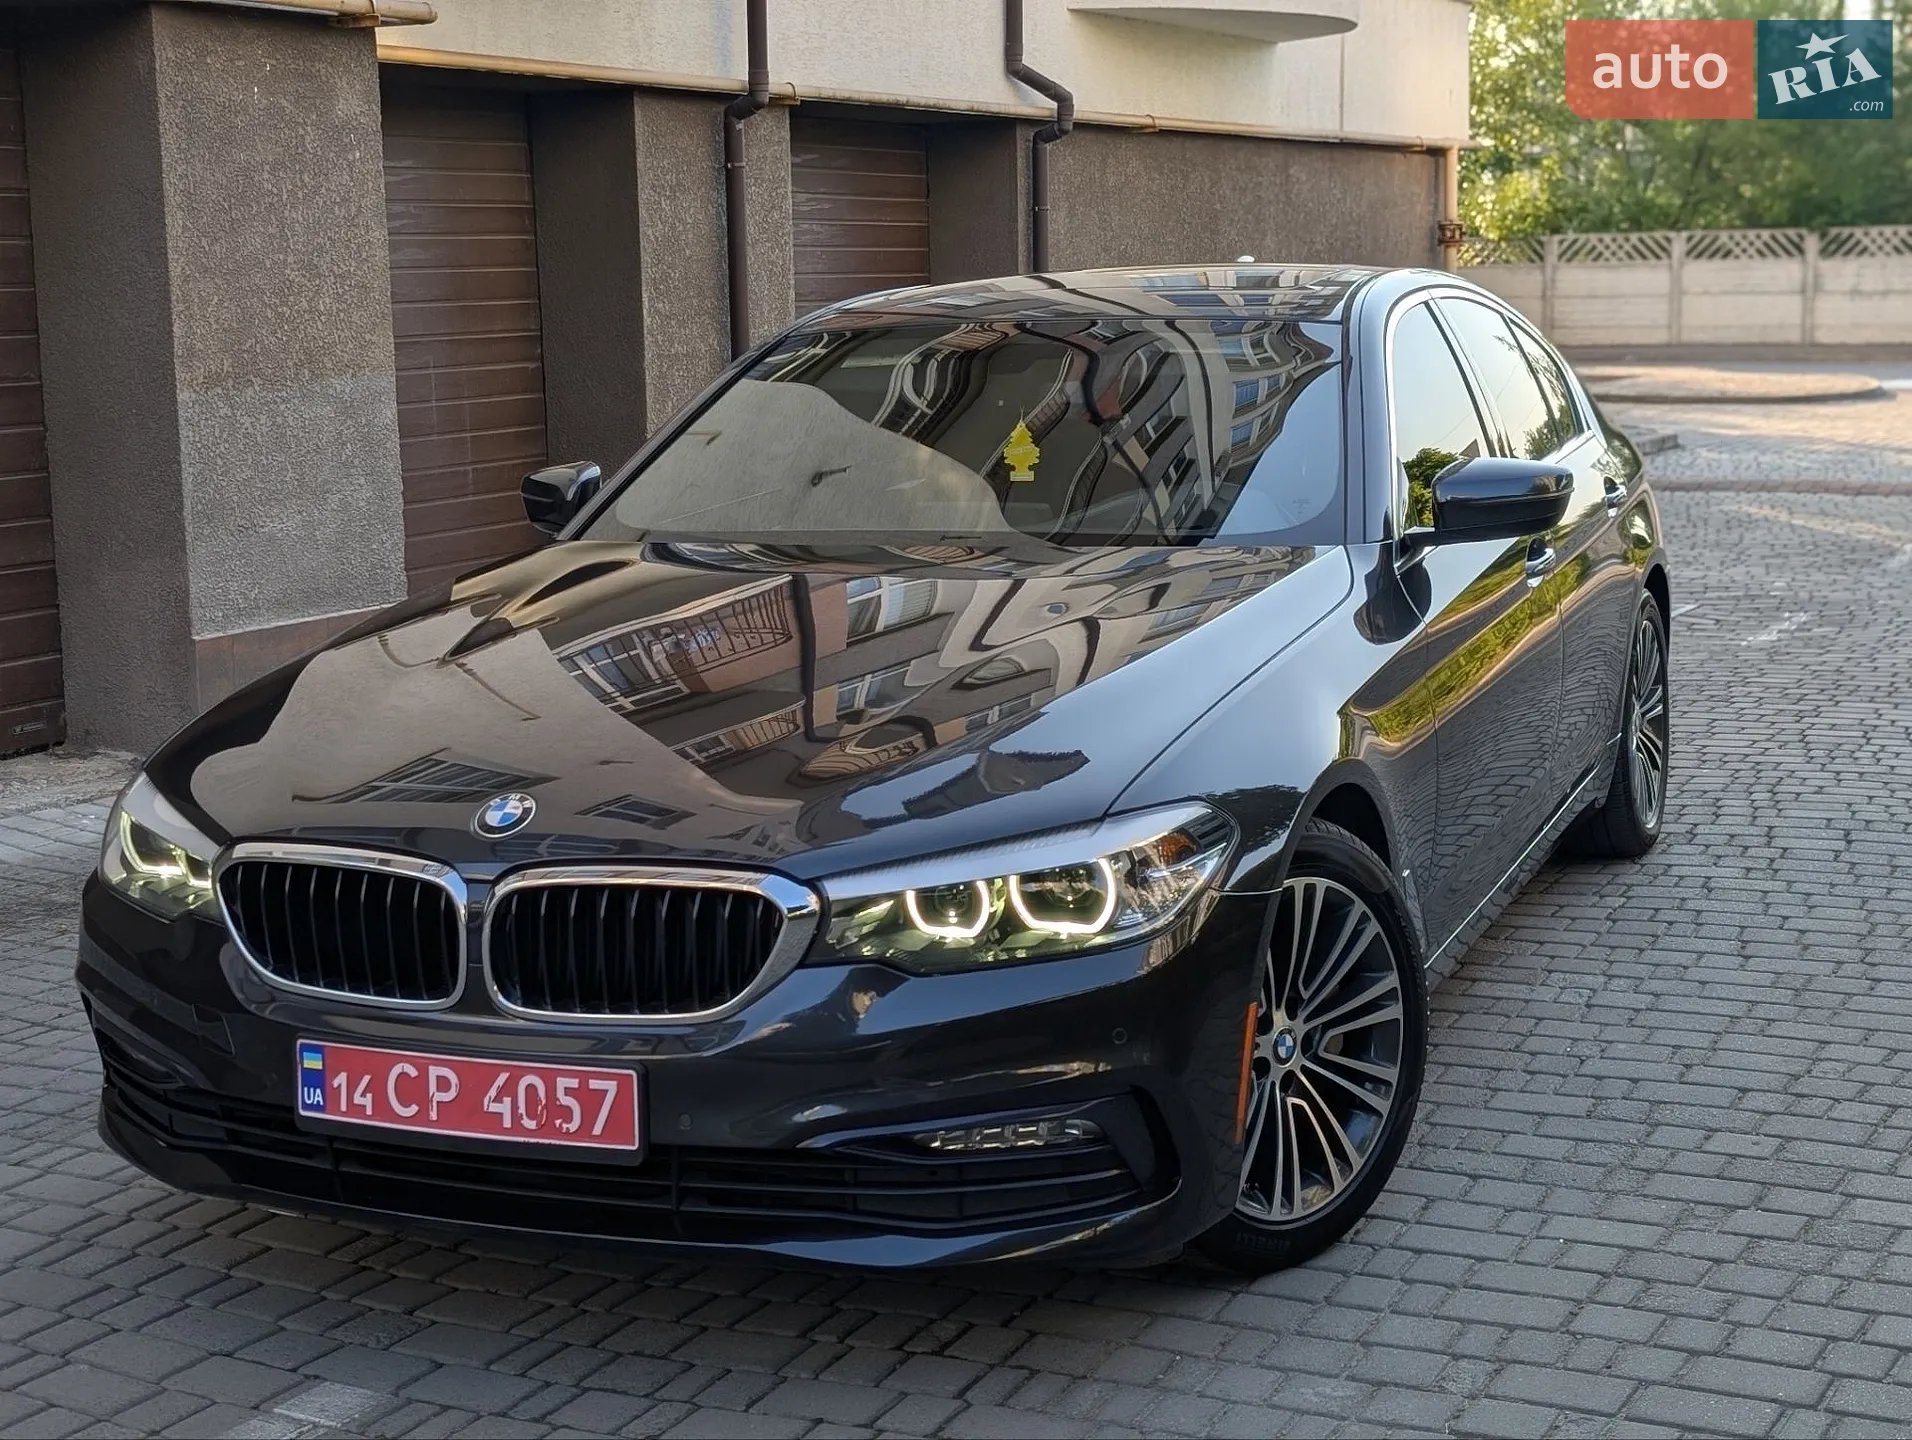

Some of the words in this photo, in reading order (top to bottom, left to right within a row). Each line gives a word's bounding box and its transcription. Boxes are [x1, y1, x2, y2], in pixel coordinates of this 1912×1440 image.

[303, 1086, 324, 1107] UA
[332, 1071, 373, 1116] 14
[386, 1062, 460, 1122] CP
[483, 1072, 619, 1137] 4057
